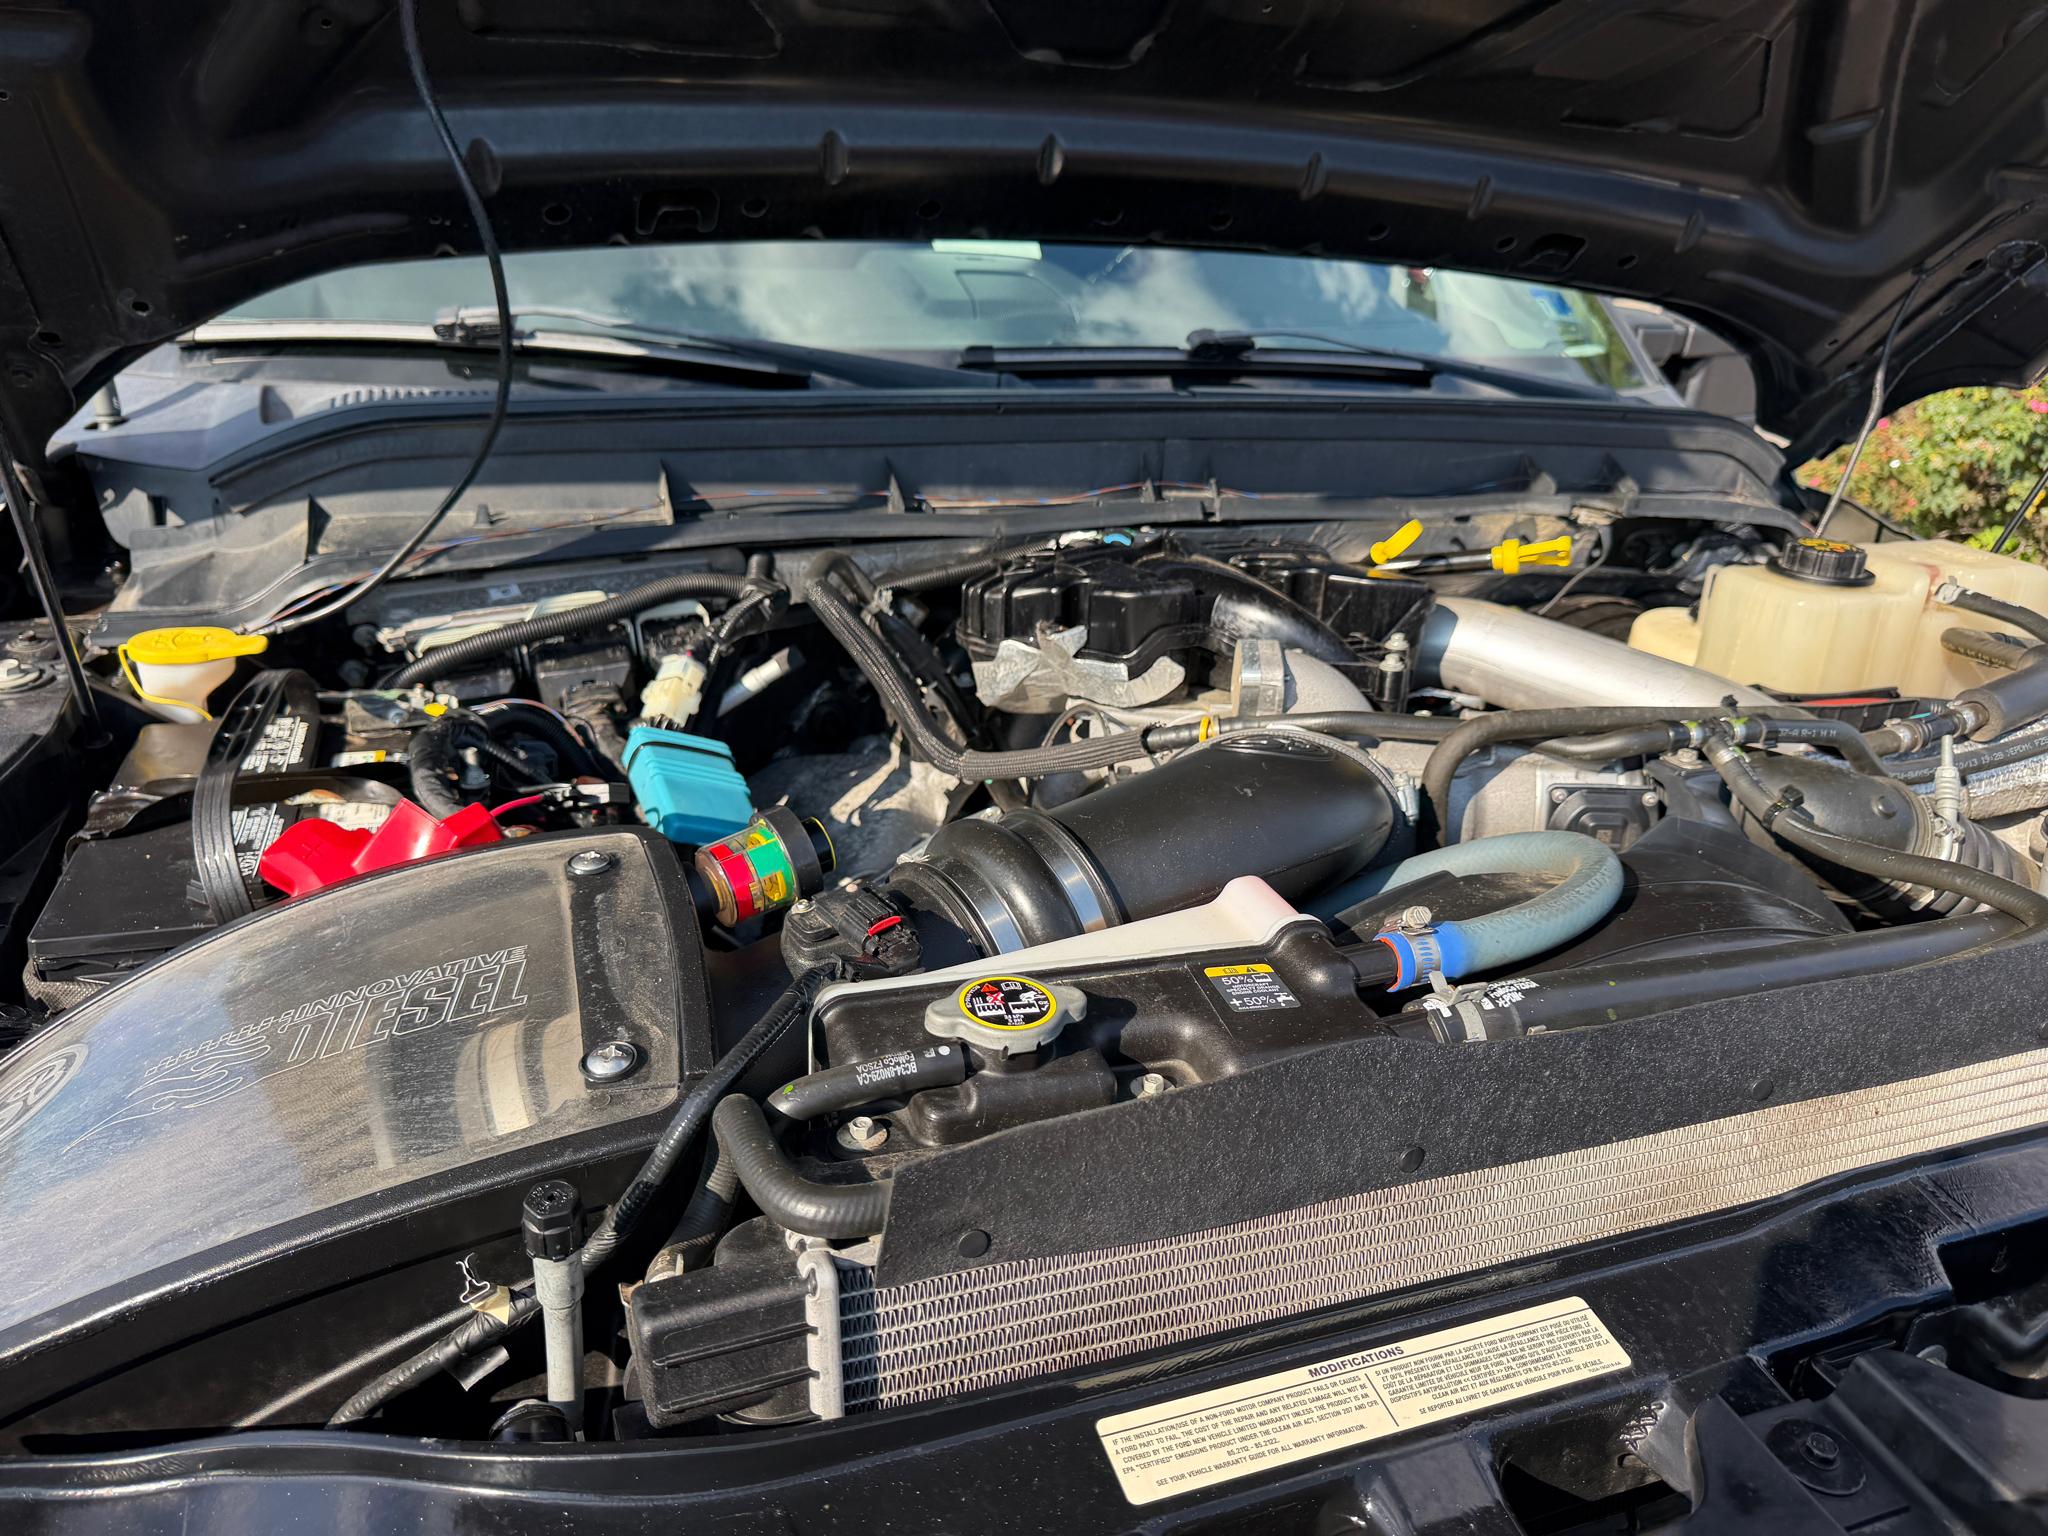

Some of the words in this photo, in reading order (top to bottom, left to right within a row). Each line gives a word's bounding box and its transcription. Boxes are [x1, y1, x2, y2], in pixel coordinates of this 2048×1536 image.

[279, 959, 528, 1065] DIESEL
[293, 945, 528, 1021] INNOVATIVE
[1222, 975, 1253, 985] 50%
[1243, 995, 1276, 1006] 50%
[1308, 1346, 1403, 1377] MODIFICATIONS
[1119, 1434, 1133, 1443] THE
[1204, 1408, 1235, 1421] NON-FORD
[1235, 1402, 1257, 1412] MOTOR
[1257, 1395, 1285, 1407] COMPANY
[1285, 1387, 1312, 1399] PRODUCT
[1312, 1383, 1329, 1392] FAILS
[1338, 1375, 1361, 1385] CAUSES
[1120, 1444, 1138, 1453] FORD
[1138, 1439, 1154, 1449] PART
[1180, 1428, 1194, 1437] THE
[1193, 1424, 1210, 1434] COST
[1219, 1418, 1233, 1427] THE
[1232, 1413, 1255, 1423] REPAIR
[1255, 1409, 1268, 1417] AND
[1268, 1406, 1281, 1414] ANY
[1281, 1399, 1307, 1410] RELATED
[1307, 1392, 1332, 1403] DAMAGE
[1331, 1388, 1347, 1397] WILL
[1346, 1385, 1358, 1393] NOT
[1121, 1466, 1135, 1474] EPA
[1174, 1446, 1208, 1460] EMISSIONS
[1208, 1438, 1236, 1450] PRODUCT
[1237, 1432, 1259, 1443] UNDER
[1258, 1428, 1271, 1437] THE
[1271, 1423, 1291, 1433] CLEAN
[1291, 1420, 1303, 1428] AIR
[1316, 1410, 1341, 1421] SECTION
[1341, 1406, 1352, 1414] 207
[1353, 1402, 1366, 1411] AND
[1366, 1399, 1379, 1407] CFR
[1122, 1451, 1151, 1463] COVERED
[1161, 1444, 1174, 1453] THE
[1174, 1440, 1192, 1449] FORD
[1192, 1435, 1206, 1444] NEW
[1206, 1429, 1233, 1440] VEHICLE
[1232, 1422, 1257, 1434] LIMITED
[1257, 1413, 1290, 1426] WARRANTY
[1290, 1407, 1314, 1418] UNLESS
[1313, 1403, 1326, 1412] THE
[1326, 1396, 1352, 1408] PRODUCT
[1155, 1477, 1169, 1486] SEE
[1168, 1473, 1187, 1482] YOUR
[1186, 1465, 1213, 1477] VEHICLE
[1213, 1456, 1247, 1470] WARRANTY
[1248, 1450, 1267, 1460] GUIDE
[1266, 1447, 1280, 1455] FOR
[1280, 1444, 1293, 1452] ALL
[1292, 1434, 1325, 1448] WARRANTY
